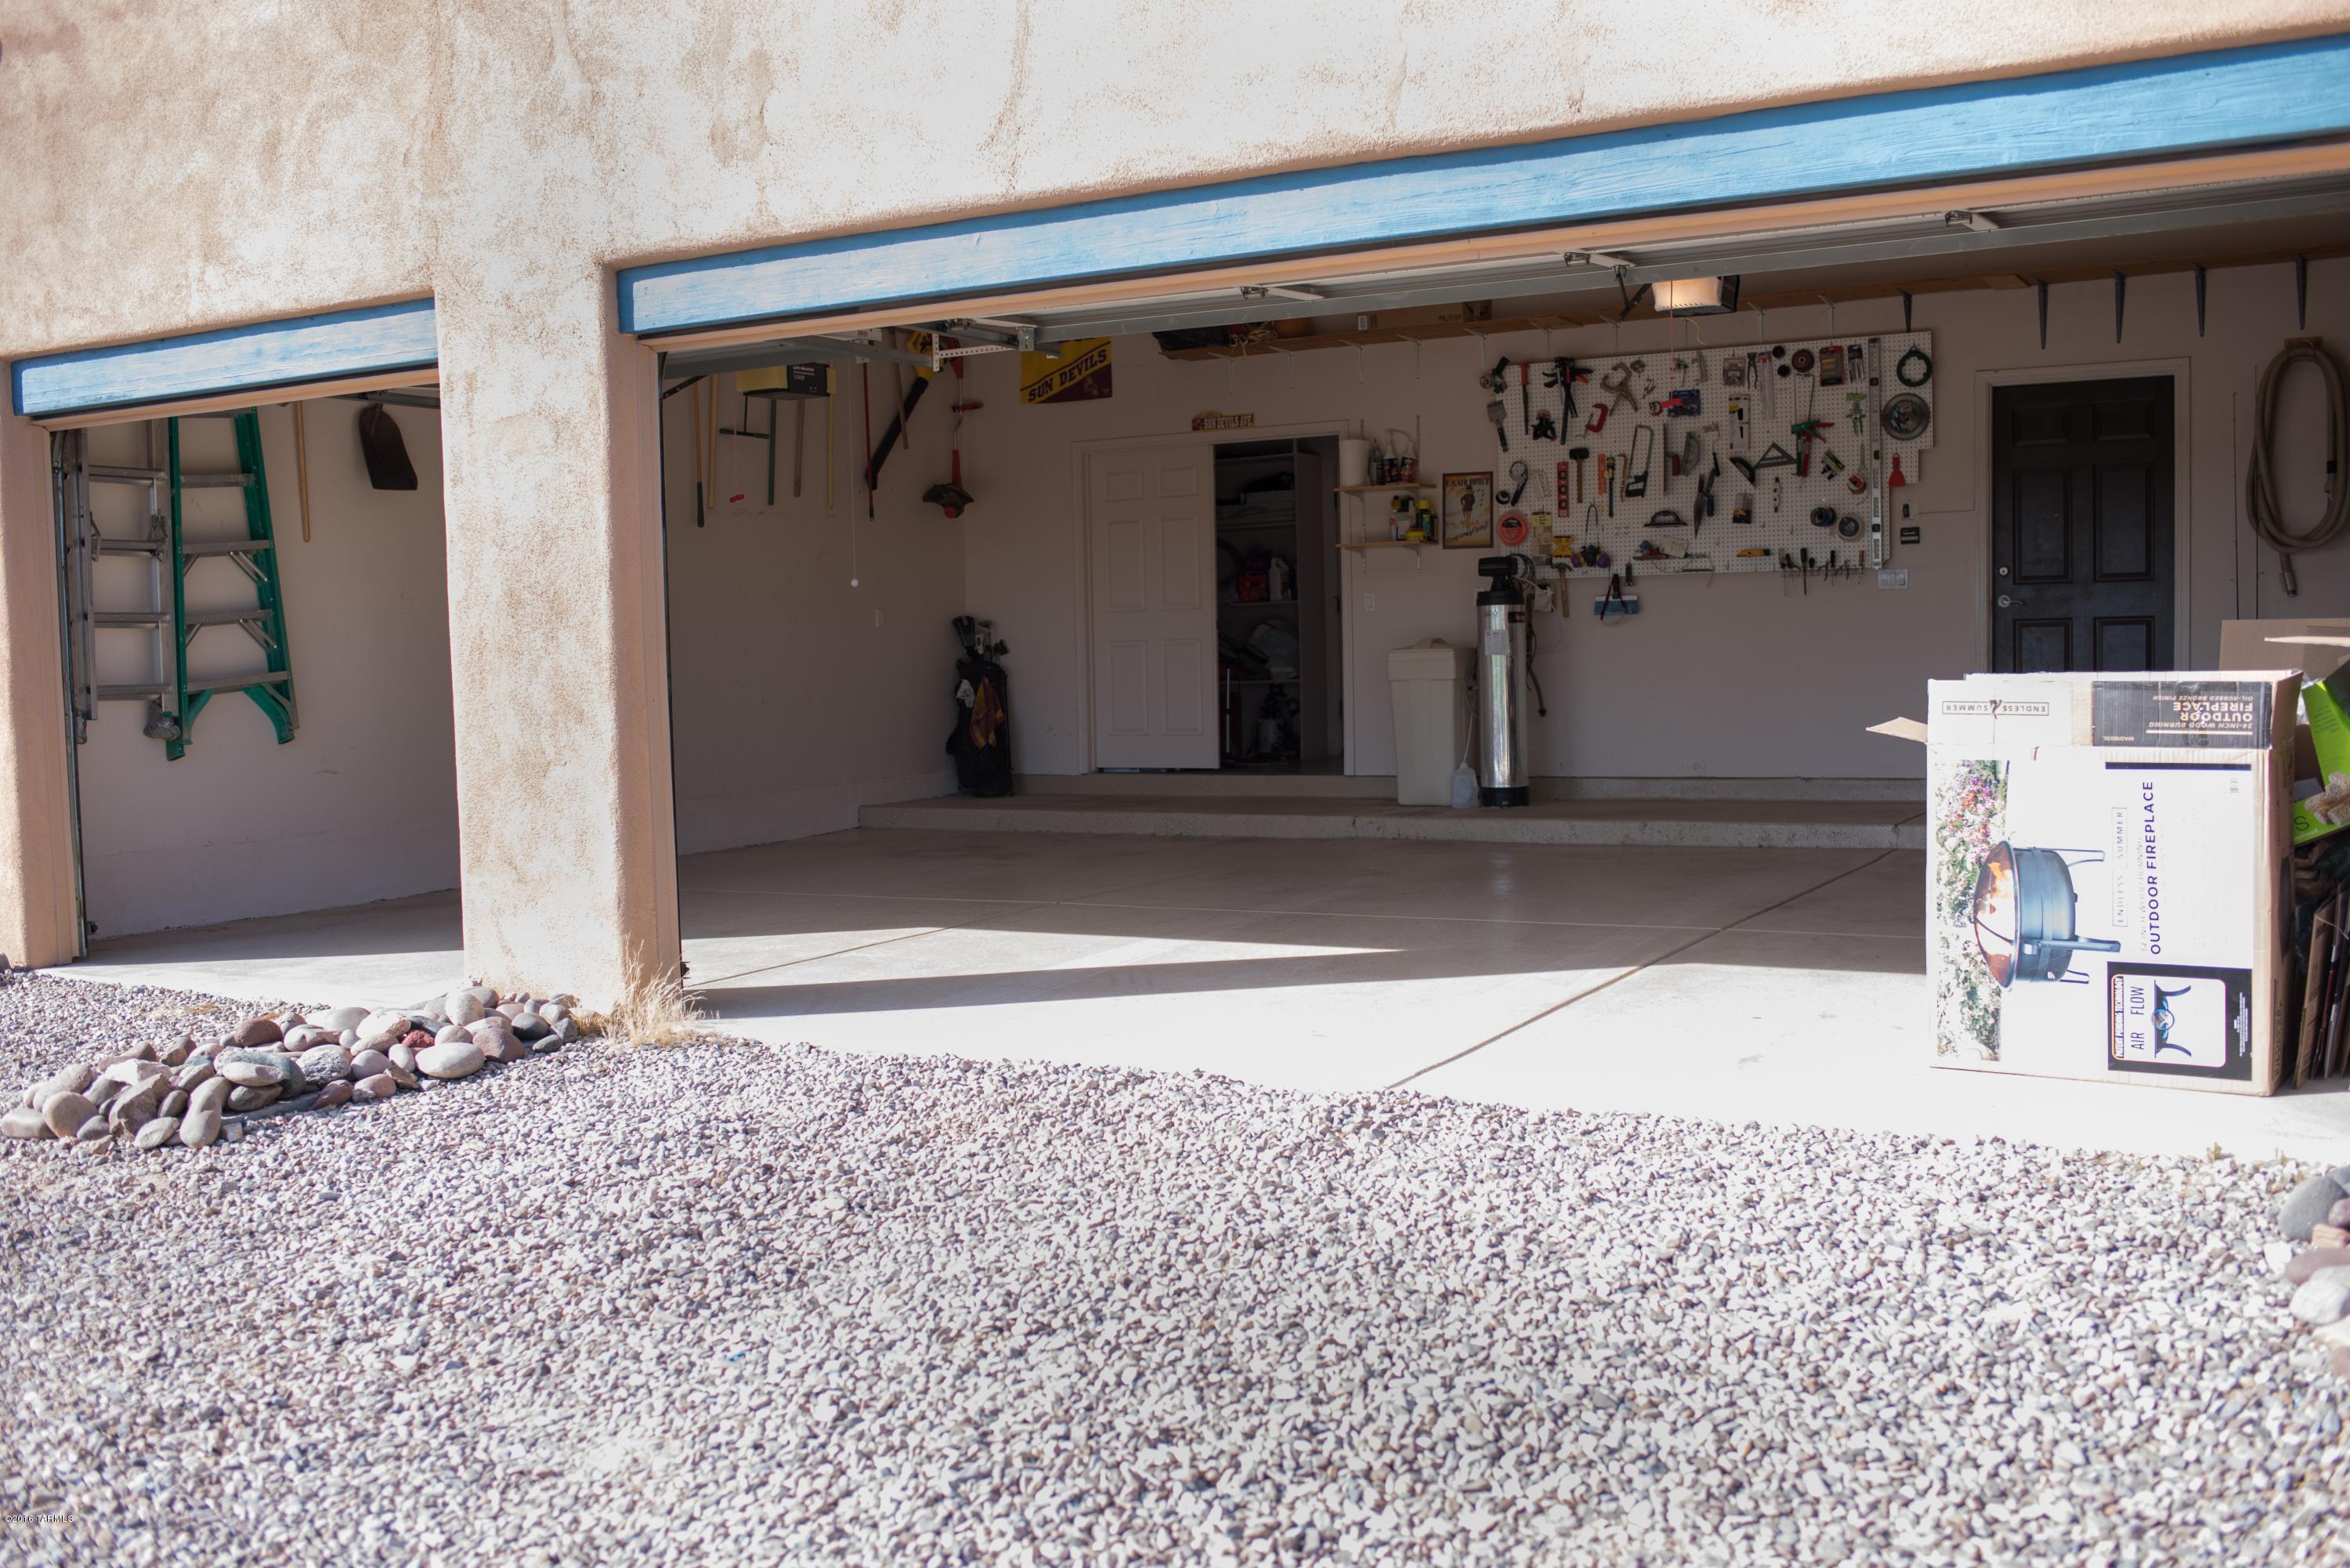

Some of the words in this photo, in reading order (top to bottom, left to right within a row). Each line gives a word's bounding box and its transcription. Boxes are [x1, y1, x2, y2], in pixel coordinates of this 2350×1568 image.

[1027, 377, 1054, 403] SUN
[1058, 349, 1107, 387] DEVILS
[1204, 418, 1216, 430] SUN
[1217, 416, 1239, 428] DEVILS
[2172, 702, 2253, 712] FIREPLACE
[2179, 711, 2253, 722] OUTDOOR
[2142, 781, 2157, 870] FIREPLACE
[2146, 875, 2161, 955] OUTDOOR
[2114, 977, 2124, 1011] TECHNOLOGY
[2130, 986, 2145, 1015] FLOW
[2115, 1012, 2124, 1036] PENDING
[2115, 1037, 2124, 1057] PATENT
[2131, 1032, 2145, 1050] AIR
